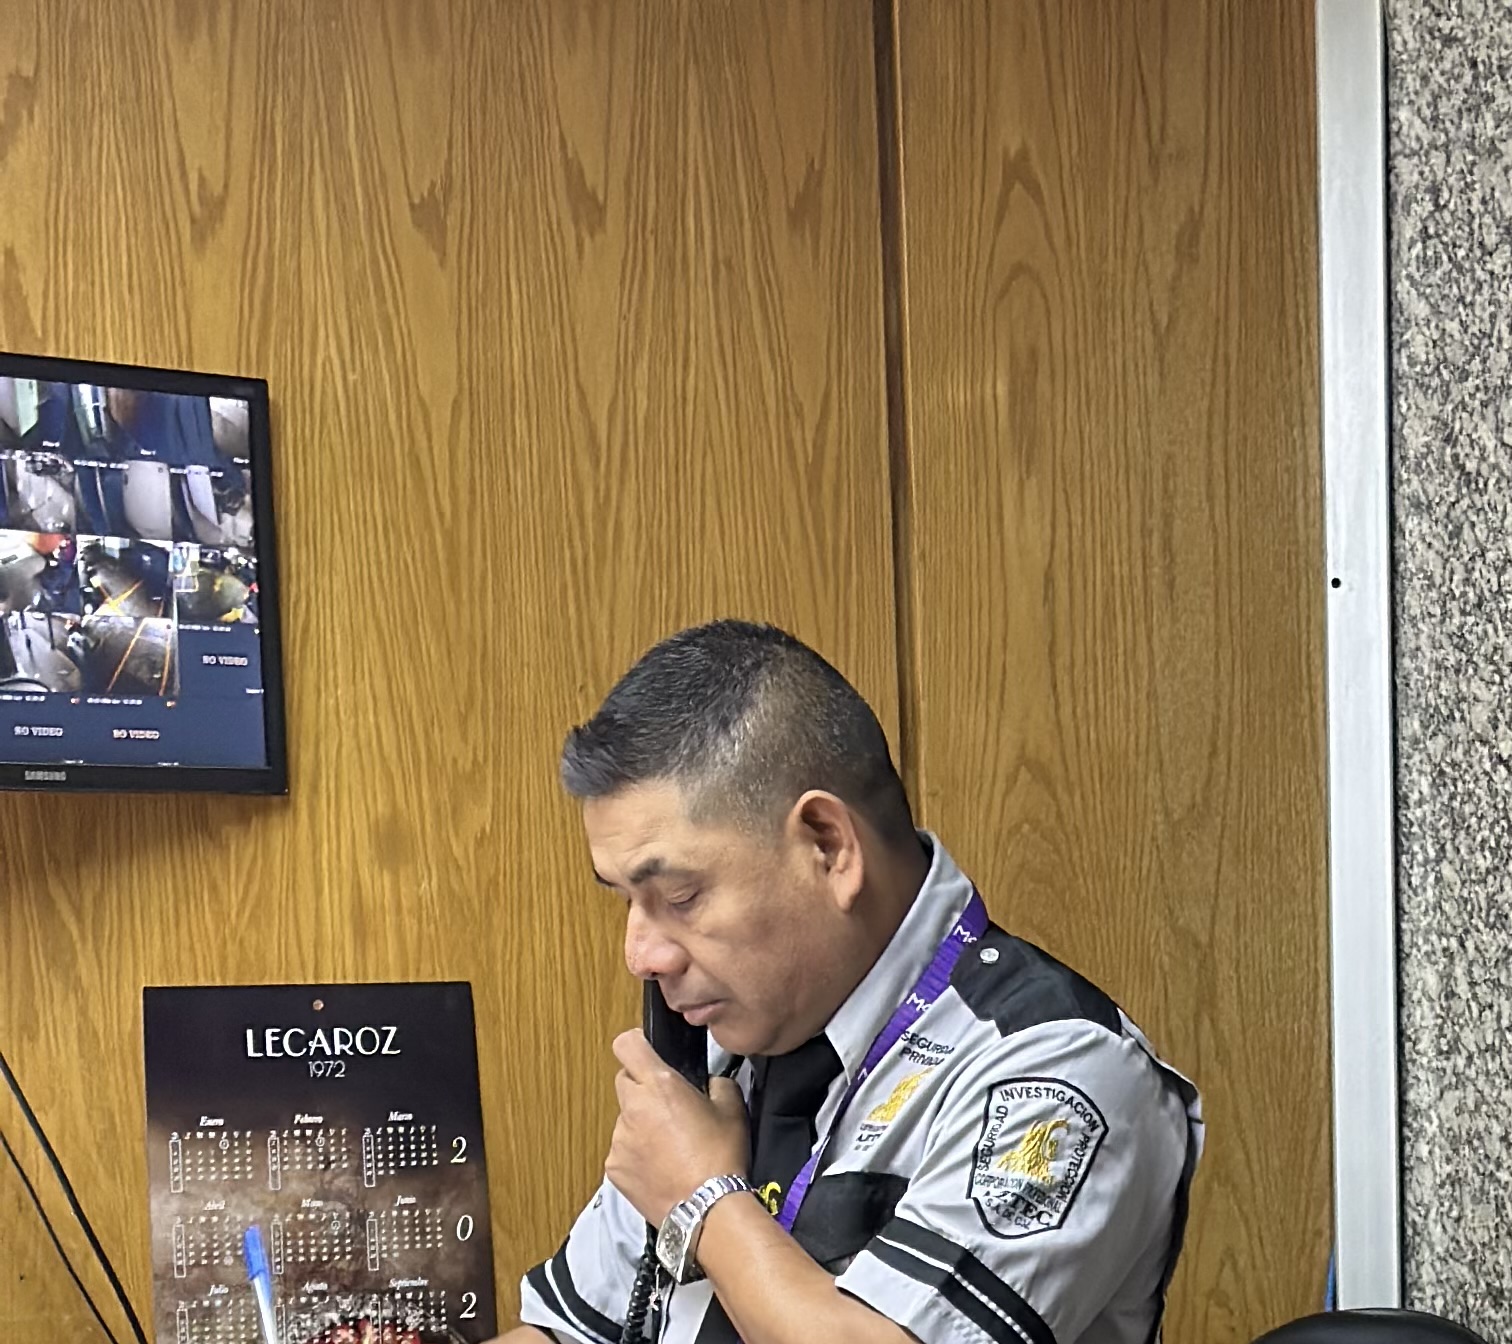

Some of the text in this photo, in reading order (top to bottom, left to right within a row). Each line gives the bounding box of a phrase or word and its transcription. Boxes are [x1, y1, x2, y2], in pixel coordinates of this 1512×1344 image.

[246, 1026, 401, 1058] LECAROZ
[308, 1060, 346, 1078] 1972
[1000, 1086, 1099, 1133] INVESTIGACION
[451, 1136, 468, 1163] 2
[456, 1215, 474, 1241] 0
[459, 1292, 477, 1319] 2
